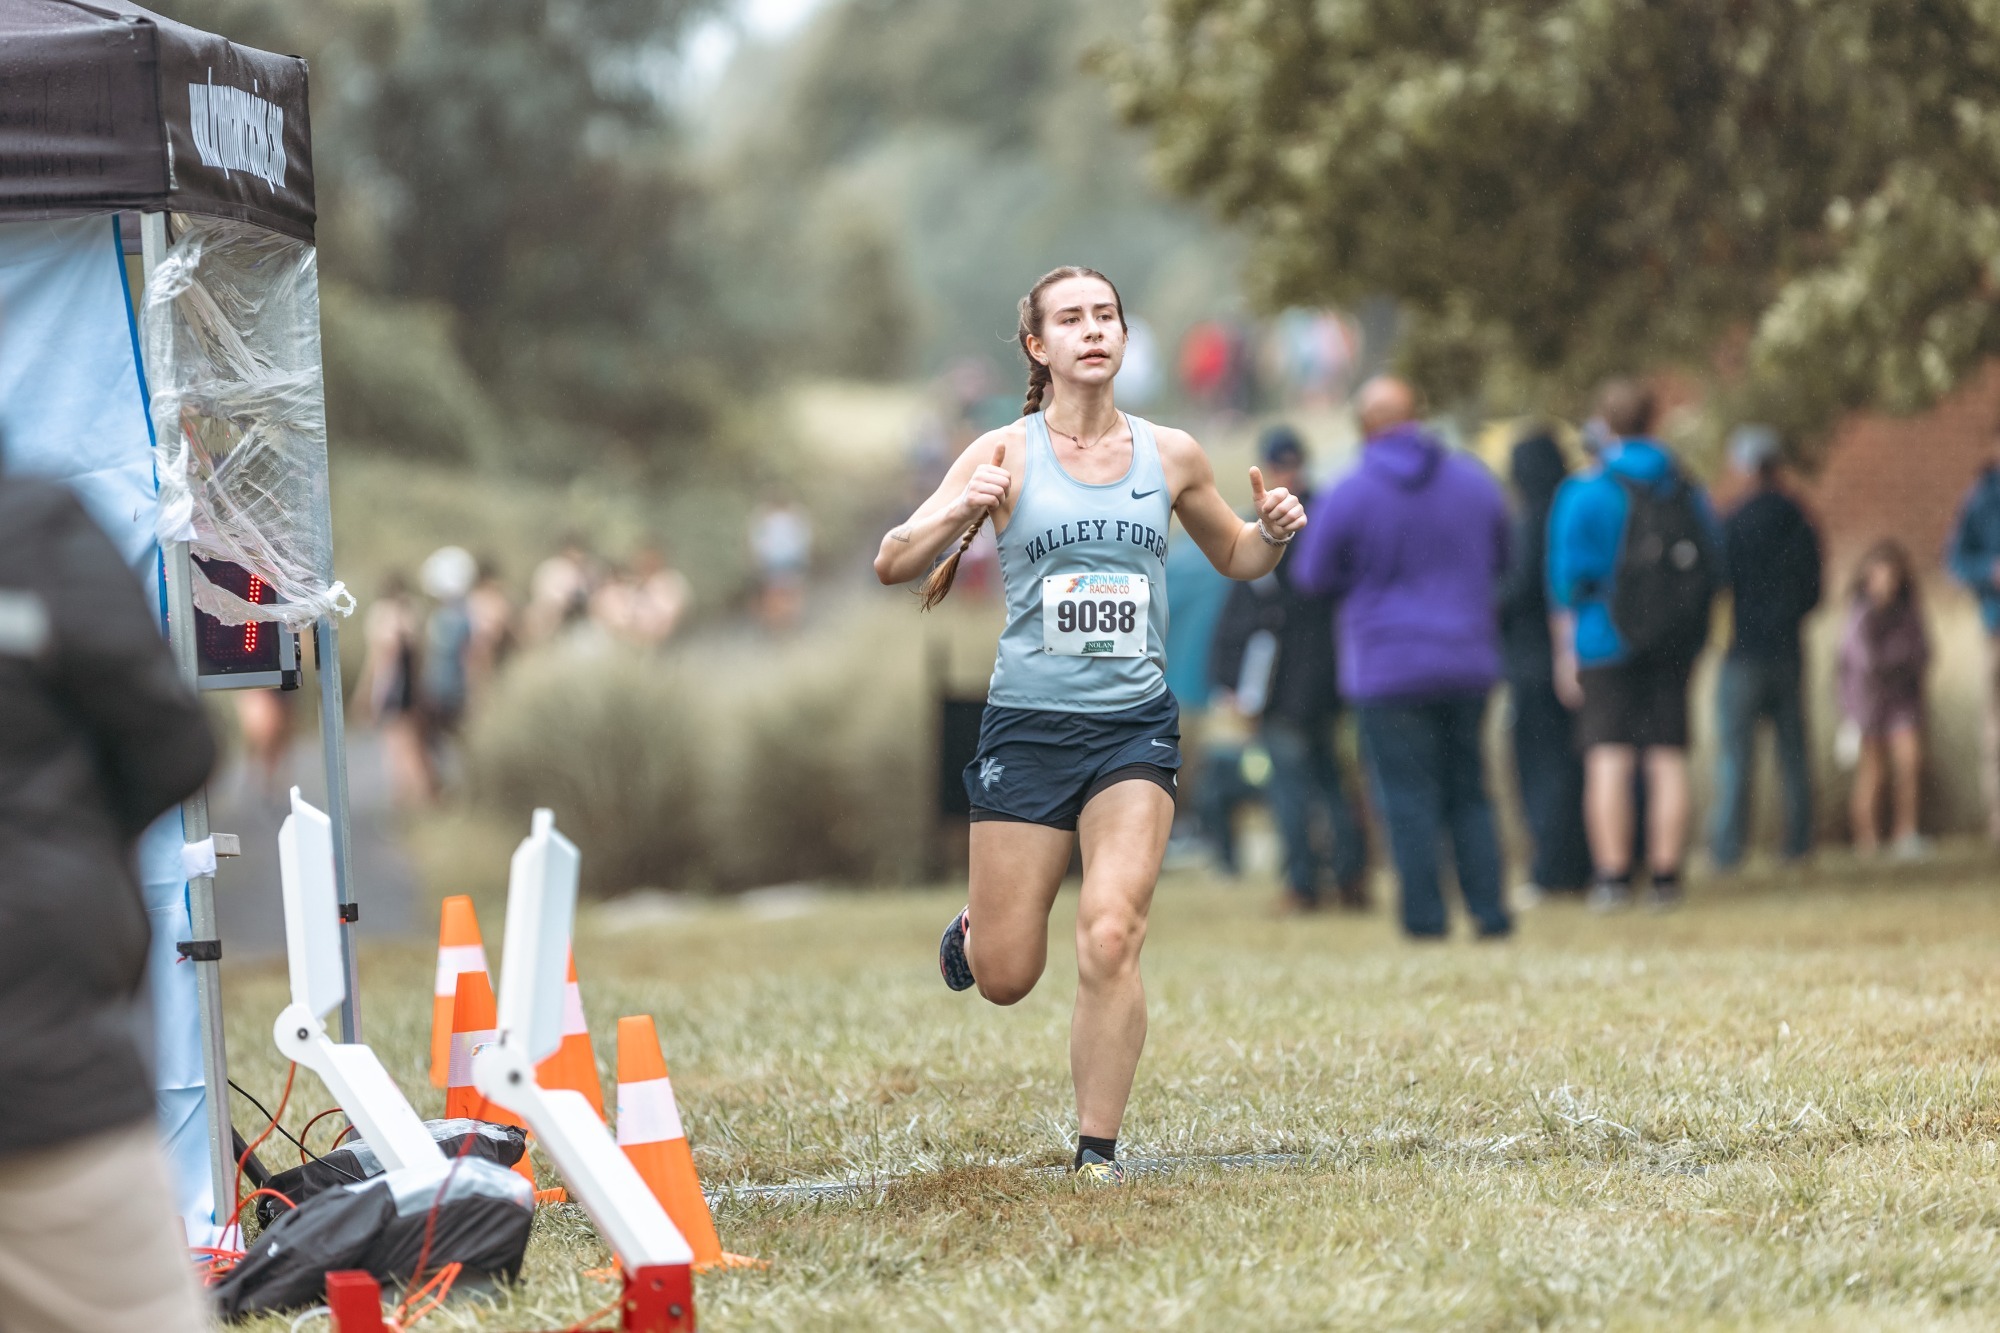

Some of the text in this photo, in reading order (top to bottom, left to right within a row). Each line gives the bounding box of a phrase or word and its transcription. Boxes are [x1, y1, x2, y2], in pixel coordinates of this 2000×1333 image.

[1025, 520, 1107, 565] VALLEY
[1090, 575, 1129, 585] BRYN MAWR
[1090, 584, 1130, 594] RACING CO
[1058, 600, 1136, 633] 9038
[978, 756, 1006, 792] VF
